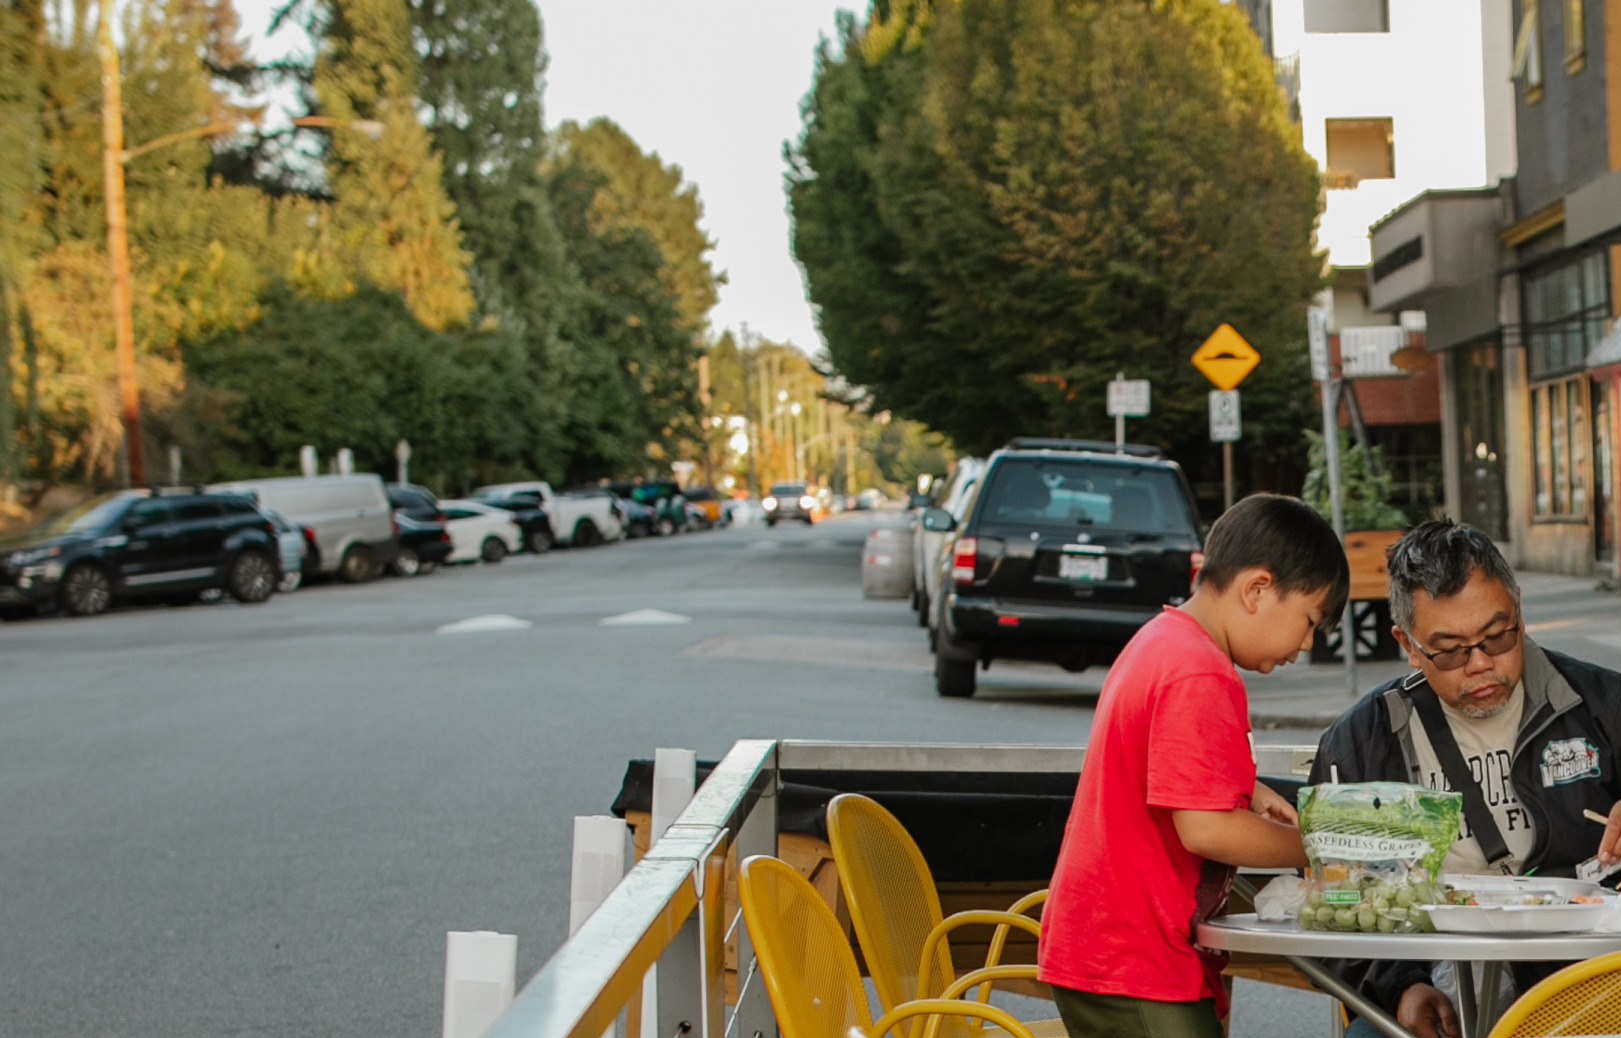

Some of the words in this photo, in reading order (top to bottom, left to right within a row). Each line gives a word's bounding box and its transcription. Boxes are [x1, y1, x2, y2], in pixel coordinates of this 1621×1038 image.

[1541, 752, 1600, 788] VANCOUVER
[1315, 834, 1374, 850] SEEDLESS
[1378, 840, 1423, 852] GRAPES
